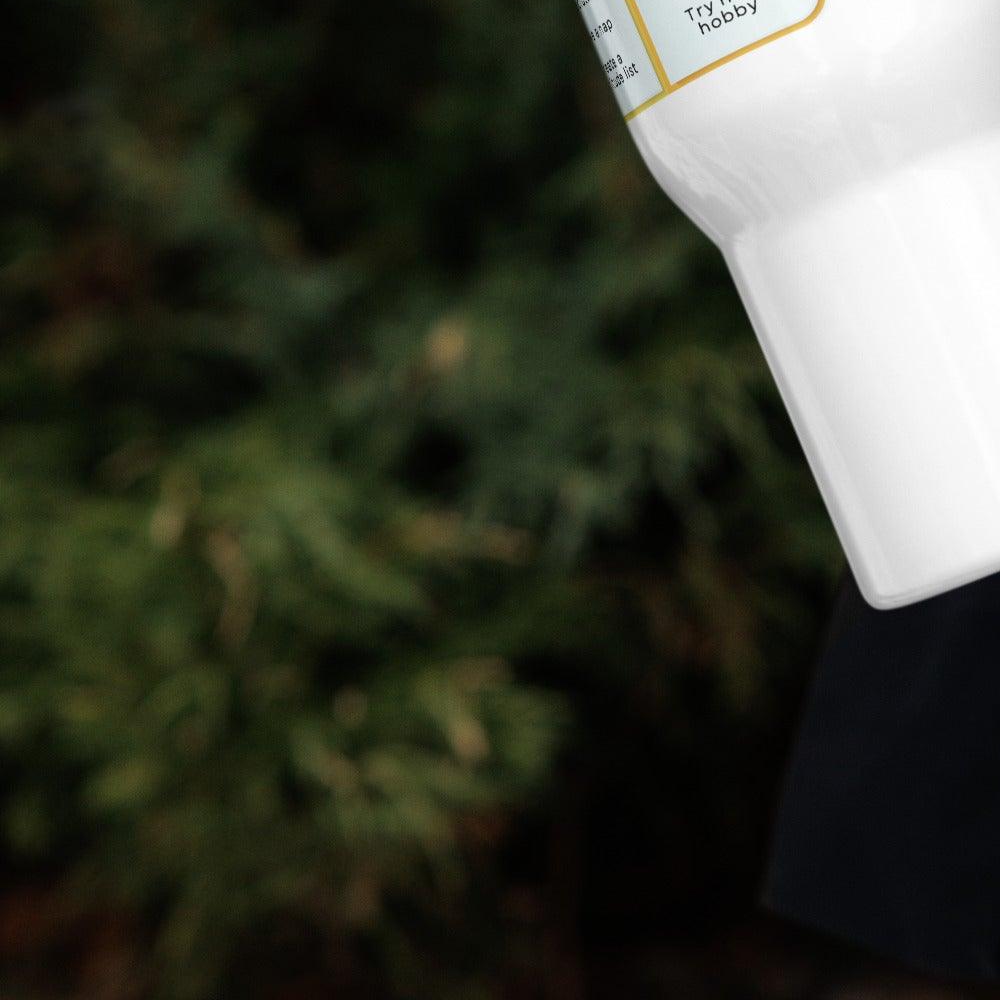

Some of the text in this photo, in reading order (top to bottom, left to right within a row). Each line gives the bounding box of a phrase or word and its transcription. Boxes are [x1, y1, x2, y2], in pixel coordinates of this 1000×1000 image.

[684, 1, 714, 21] Try
[698, 0, 757, 35] hobby
[623, 62, 639, 80] list
